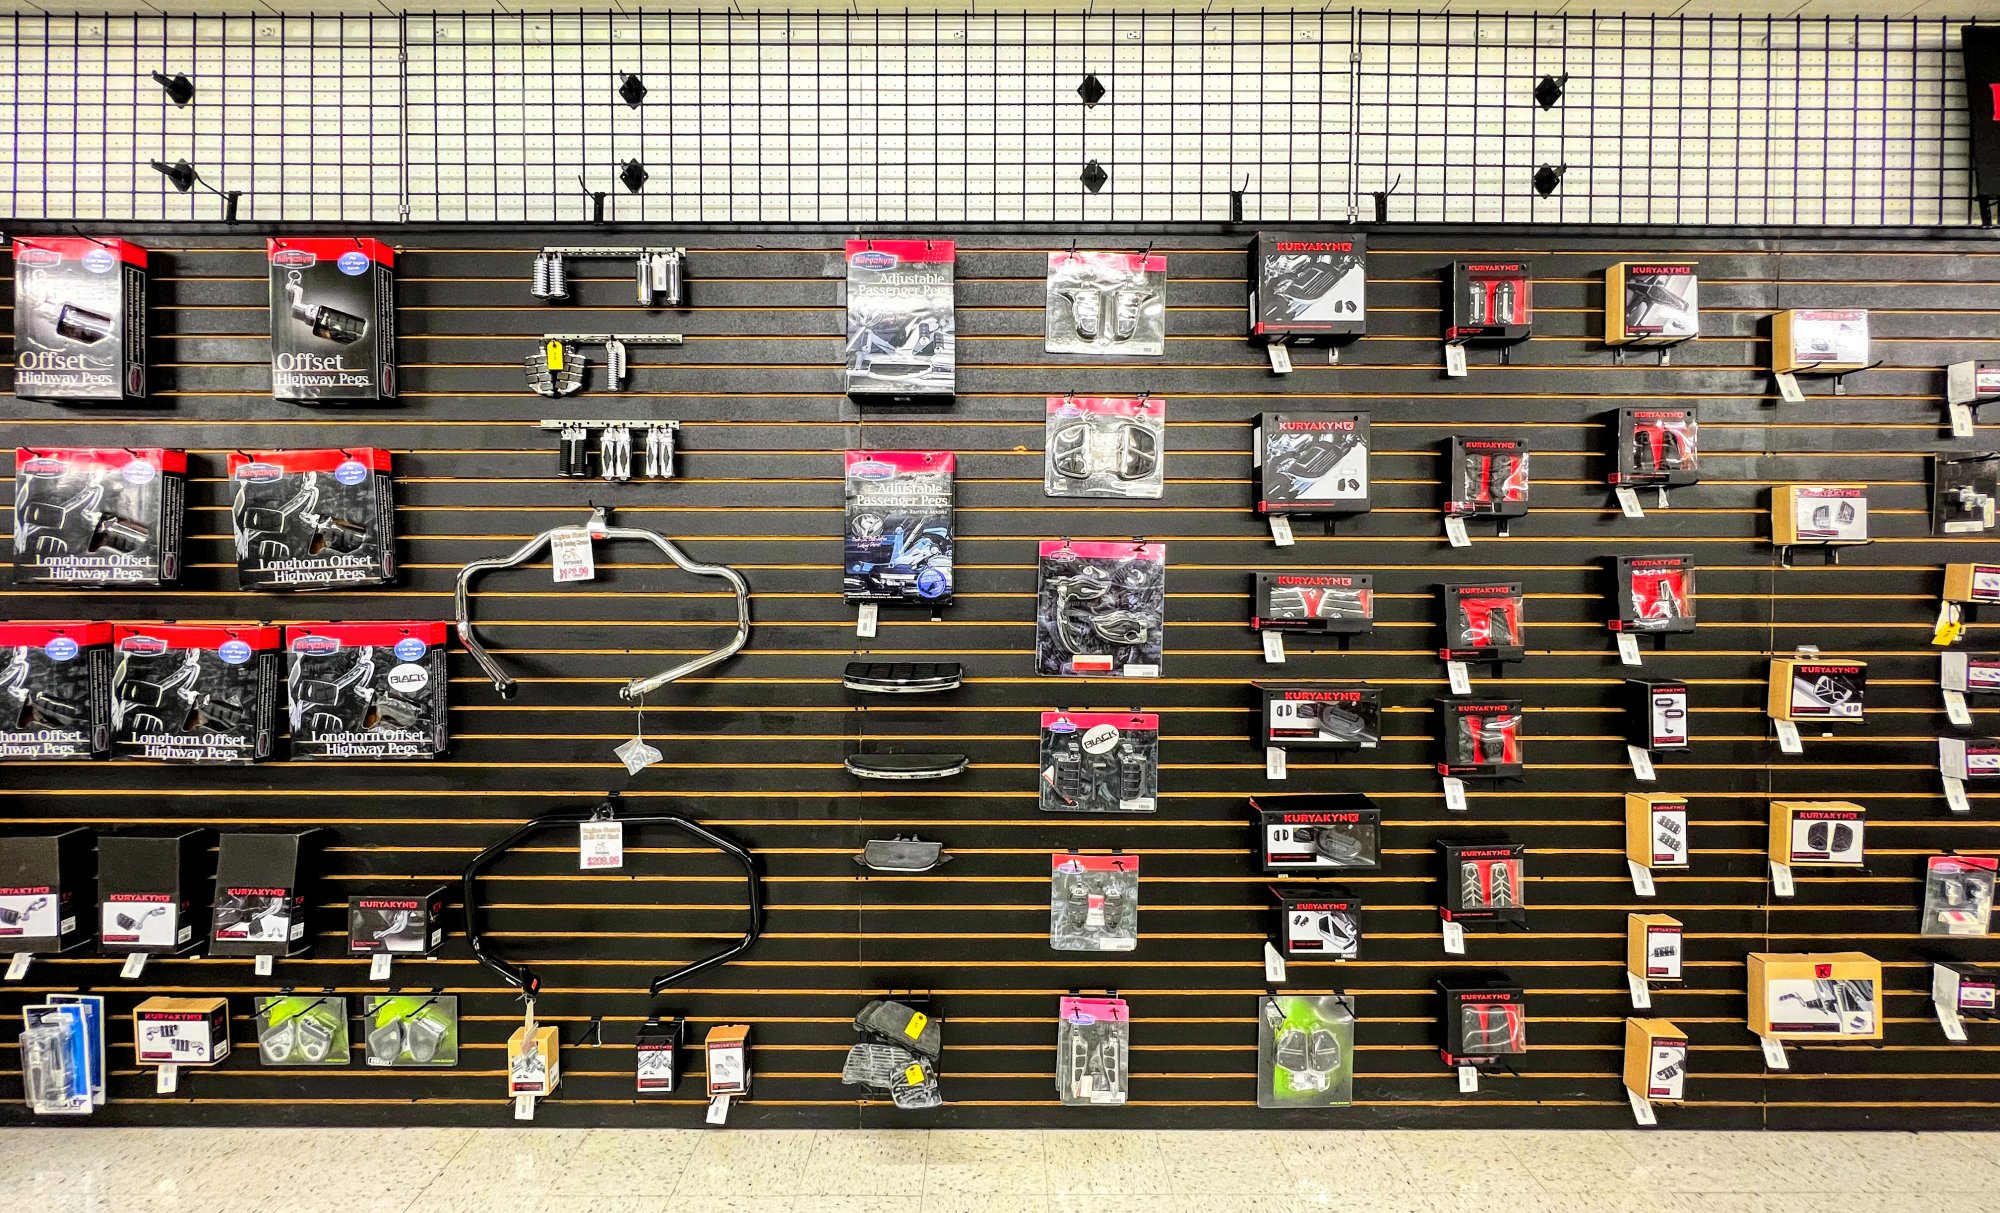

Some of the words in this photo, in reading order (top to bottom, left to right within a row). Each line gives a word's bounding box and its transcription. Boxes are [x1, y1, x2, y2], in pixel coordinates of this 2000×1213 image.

[879, 273, 945, 286] Adjustable
[858, 285, 919, 297] Passenger
[923, 285, 949, 297] Pegs
[19, 350, 87, 370] Offset
[276, 352, 344, 371] Offset
[18, 371, 78, 388] Highway
[81, 371, 113, 388] Pegs
[276, 373, 336, 388] Highway
[338, 373, 370, 388] Pegs
[877, 482, 943, 496] Adjustable
[856, 494, 918, 508] Passenger
[920, 494, 948, 508] Pegs
[36, 554, 105, 568] Longhorn
[108, 554, 152, 567] Offset
[259, 557, 328, 571] Longhorn
[329, 555, 373, 567] Offset
[50, 568, 110, 582] Highway
[113, 568, 143, 582] Pegs
[274, 569, 333, 585] Highway
[336, 568, 366, 583] Pegs
[390, 673, 426, 684] BLACK
[0, 729, 35, 743] horn
[38, 729, 81, 743] Offset
[132, 731, 205, 747] Longhorn
[207, 733, 246, 747] Offset
[311, 730, 380, 744] Longhorn
[383, 729, 425, 743] Offset
[1083, 729, 1118, 750] BLACK
[43, 743, 75, 758] Pegs
[145, 746, 204, 761] Highway
[207, 746, 238, 762] Pegs
[326, 743, 385, 758] Highway
[388, 743, 418, 757] Pegs
